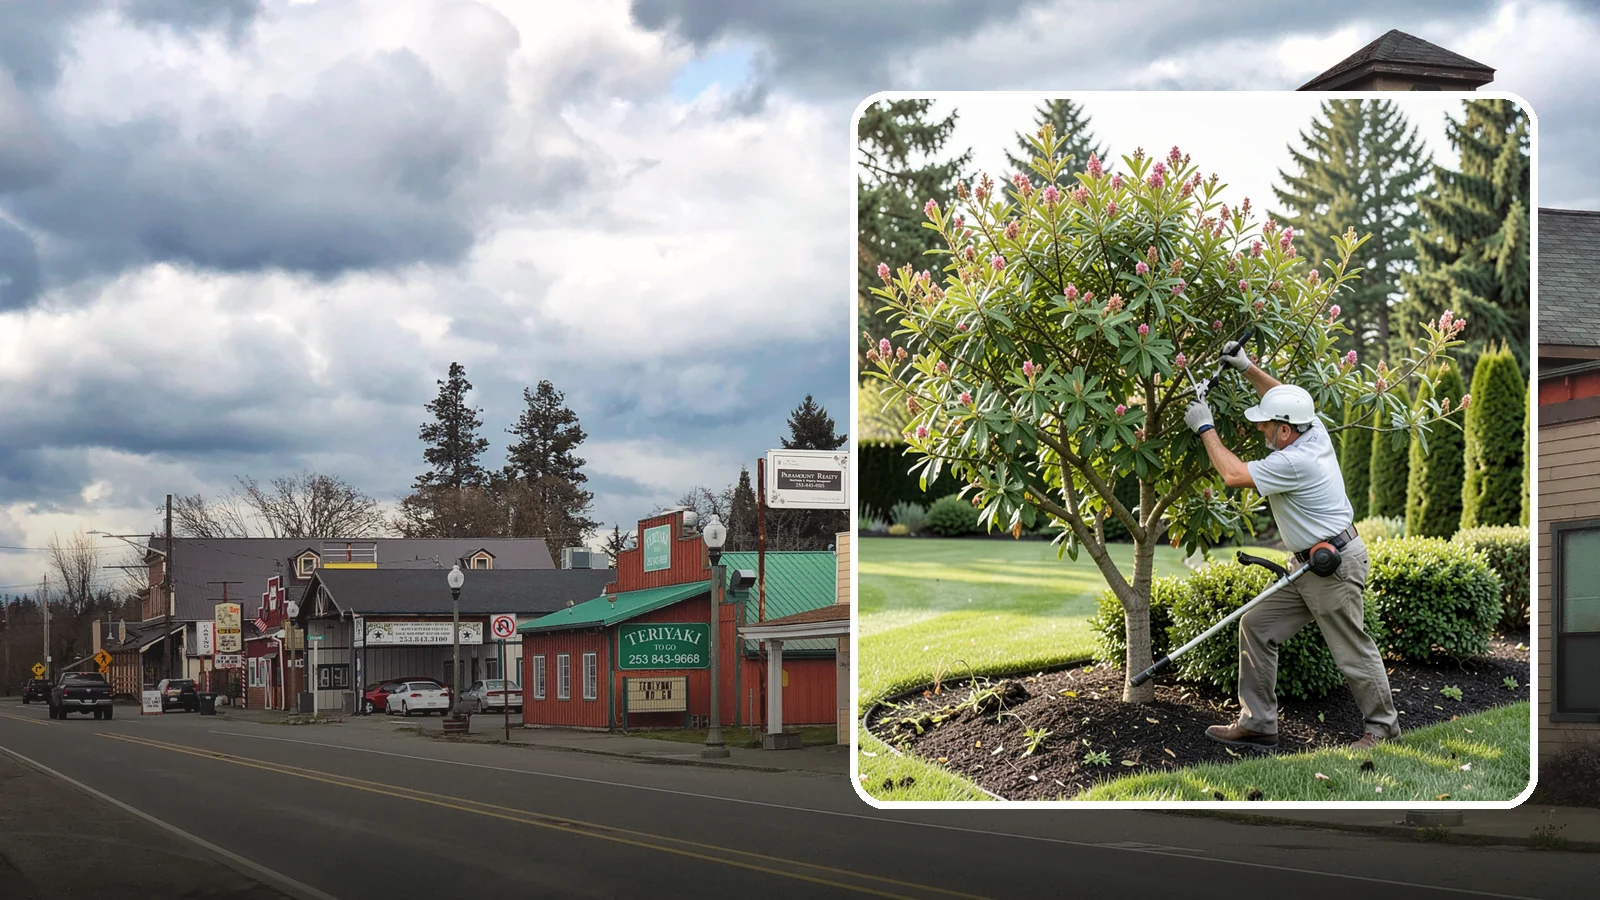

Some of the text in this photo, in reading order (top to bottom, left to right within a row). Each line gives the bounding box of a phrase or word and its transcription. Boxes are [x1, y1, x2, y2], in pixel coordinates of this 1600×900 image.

[817, 472, 838, 480] REALTY
[624, 627, 702, 646] TERIYAKI
[628, 654, 700, 664] 253 843-9668
